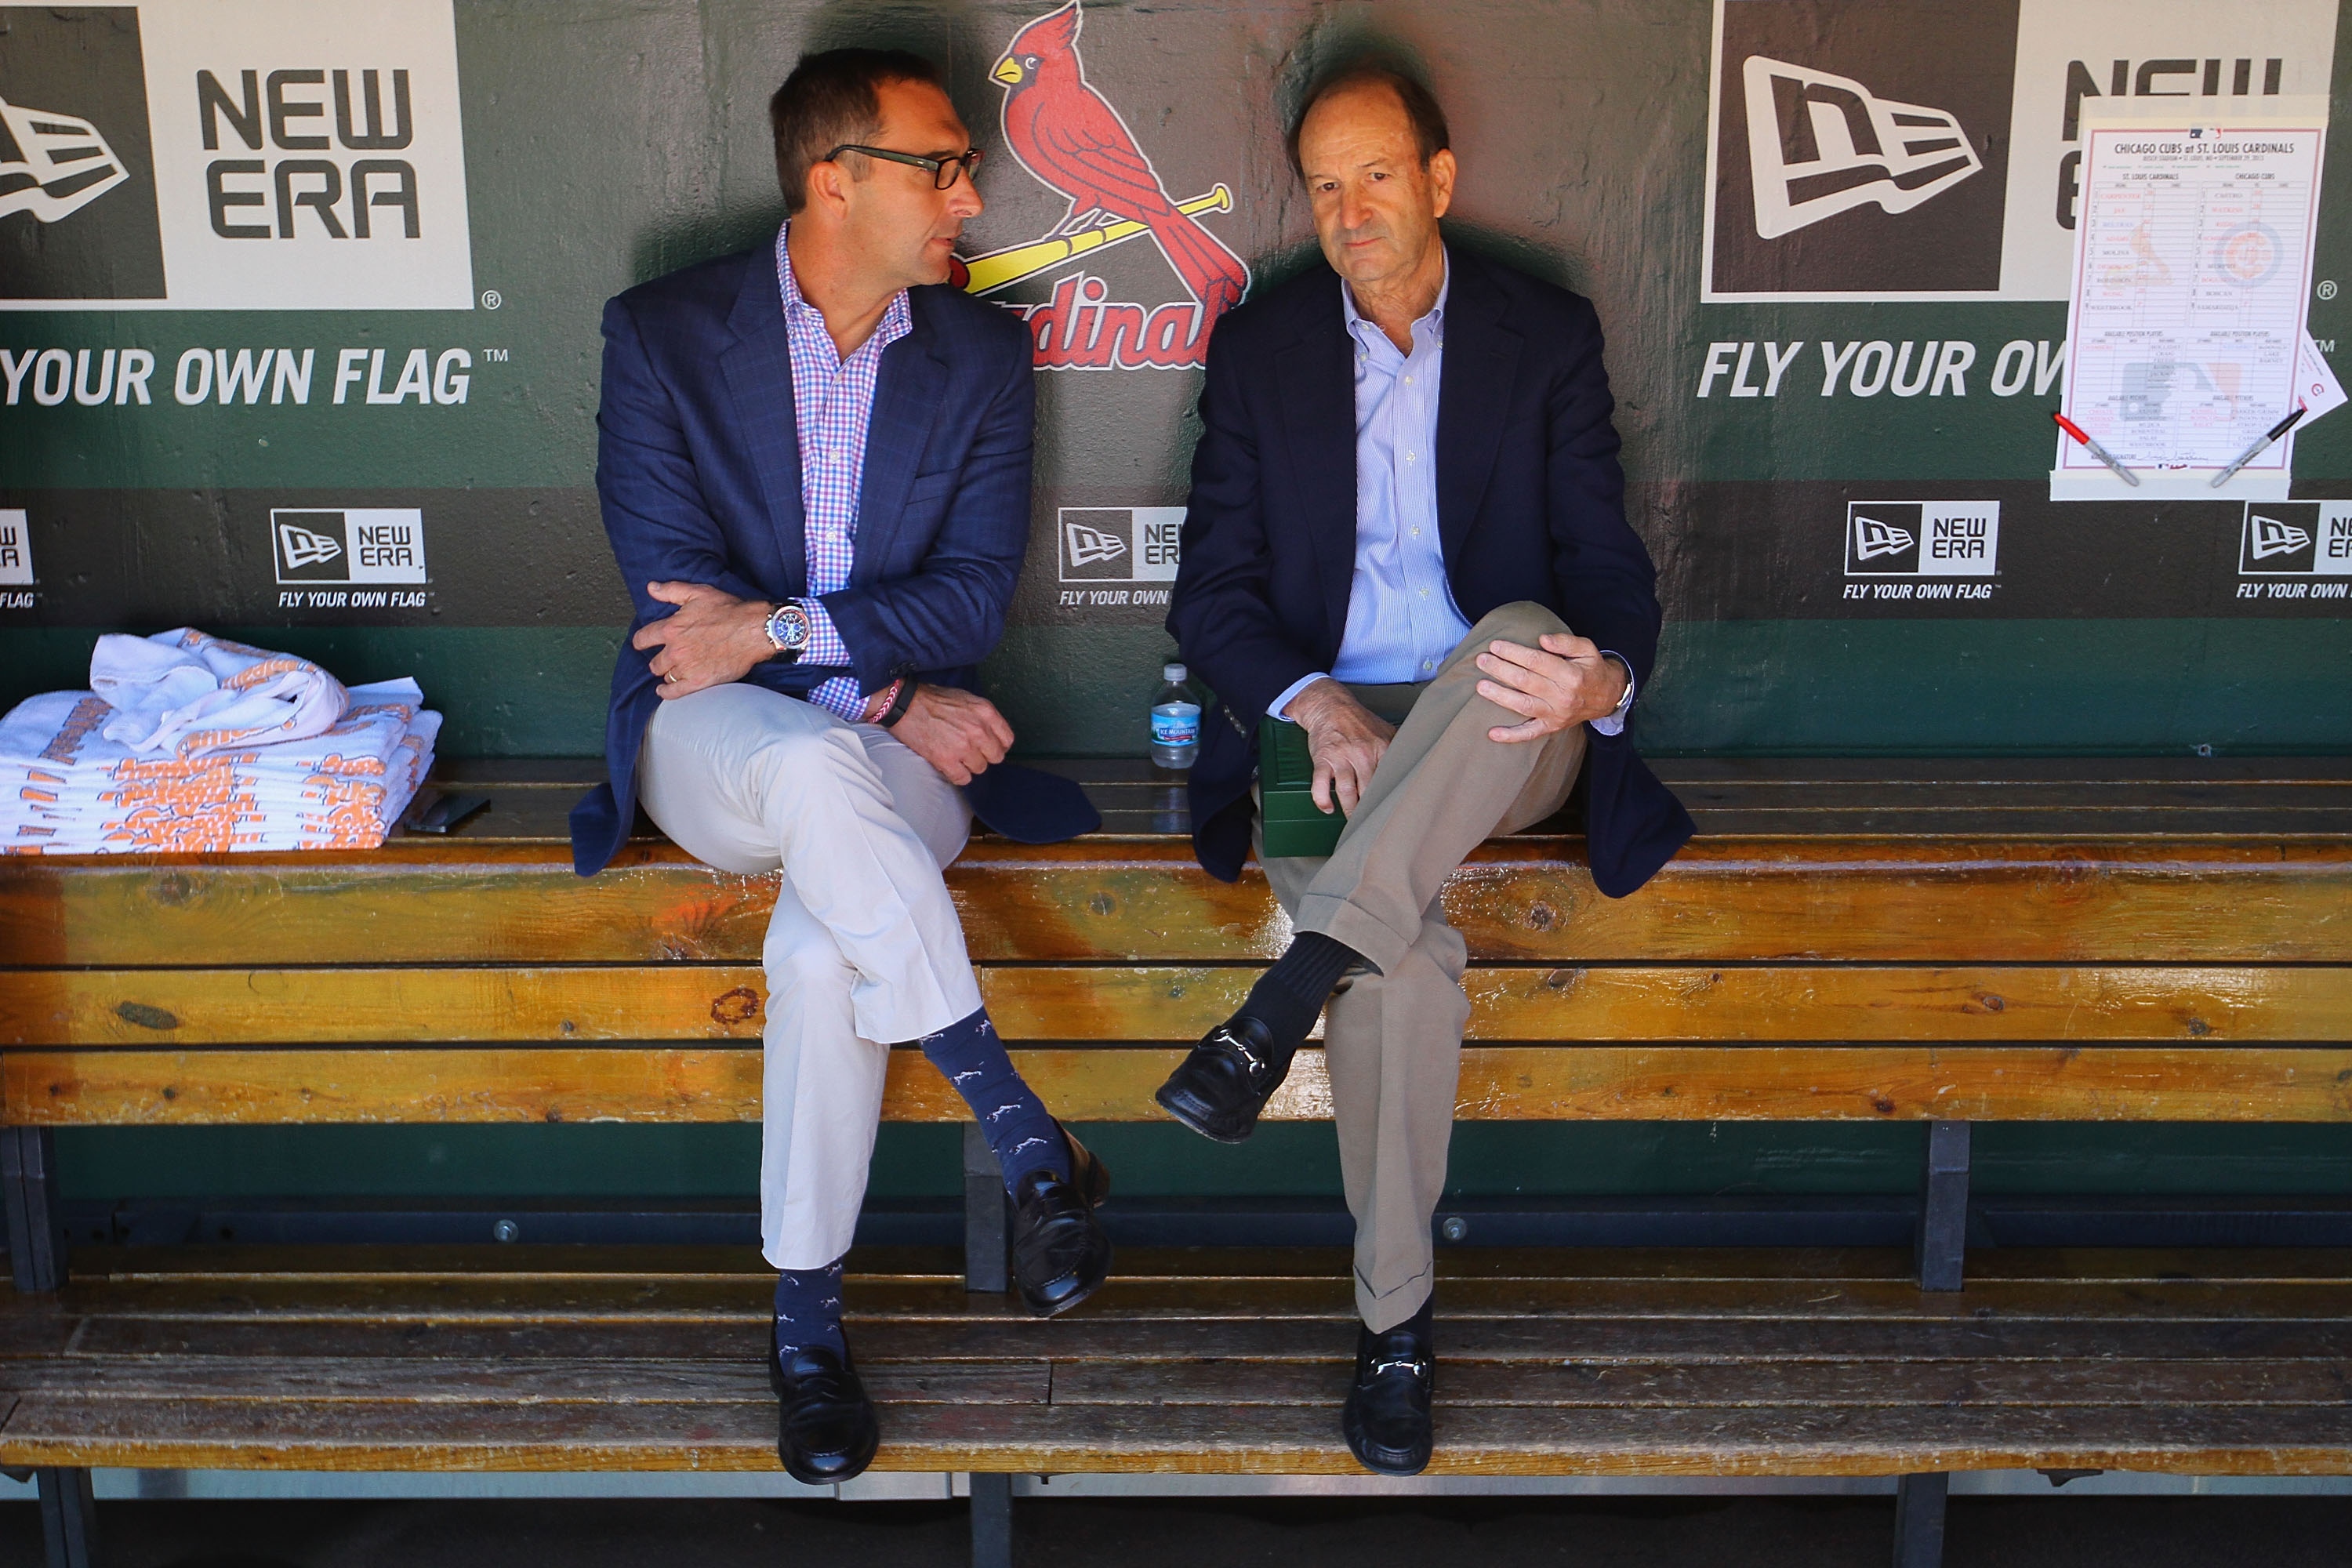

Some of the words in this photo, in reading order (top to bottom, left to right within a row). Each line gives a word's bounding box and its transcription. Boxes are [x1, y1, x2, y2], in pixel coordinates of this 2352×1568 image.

[197, 69, 414, 151] NEW
[2114, 143, 2156, 154] CHICAGO
[2158, 143, 2183, 154] CUBS
[2184, 145, 2194, 154] at
[2197, 143, 2210, 154] ST.
[2212, 143, 2239, 154] LOUIS
[2242, 143, 2295, 154] CARDINALS
[206, 159, 420, 239] ERA
[0, 348, 154, 406] YOUR
[173, 348, 313, 406] OWN
[332, 348, 470, 405] FLAG
[1697, 341, 1803, 398] FLY
[1820, 340, 1976, 397] YOUR
[358, 525, 411, 546] NEW
[1145, 524, 1182, 544] NE
[1933, 518, 1987, 538] NEW
[360, 547, 412, 567] ERA
[1145, 545, 1179, 564] ER
[1932, 539, 1985, 558] ERA
[0, 591, 34, 609] FLAG
[278, 591, 304, 608] FLY
[307, 591, 347, 608] YOUR
[351, 591, 387, 608] OWN
[390, 591, 426, 608] FLAG
[1059, 590, 1086, 605] FLY
[1090, 590, 1129, 605] YOUR
[1132, 590, 1169, 605] OWN
[1842, 583, 1870, 599] FLY
[1873, 583, 1913, 599] YOUR
[1916, 583, 1954, 599] OWN
[1955, 583, 1993, 599] FLAG
[2236, 583, 2265, 599] FLY
[2267, 583, 2308, 599] YOUR
[2310, 583, 2349, 598] OWN
